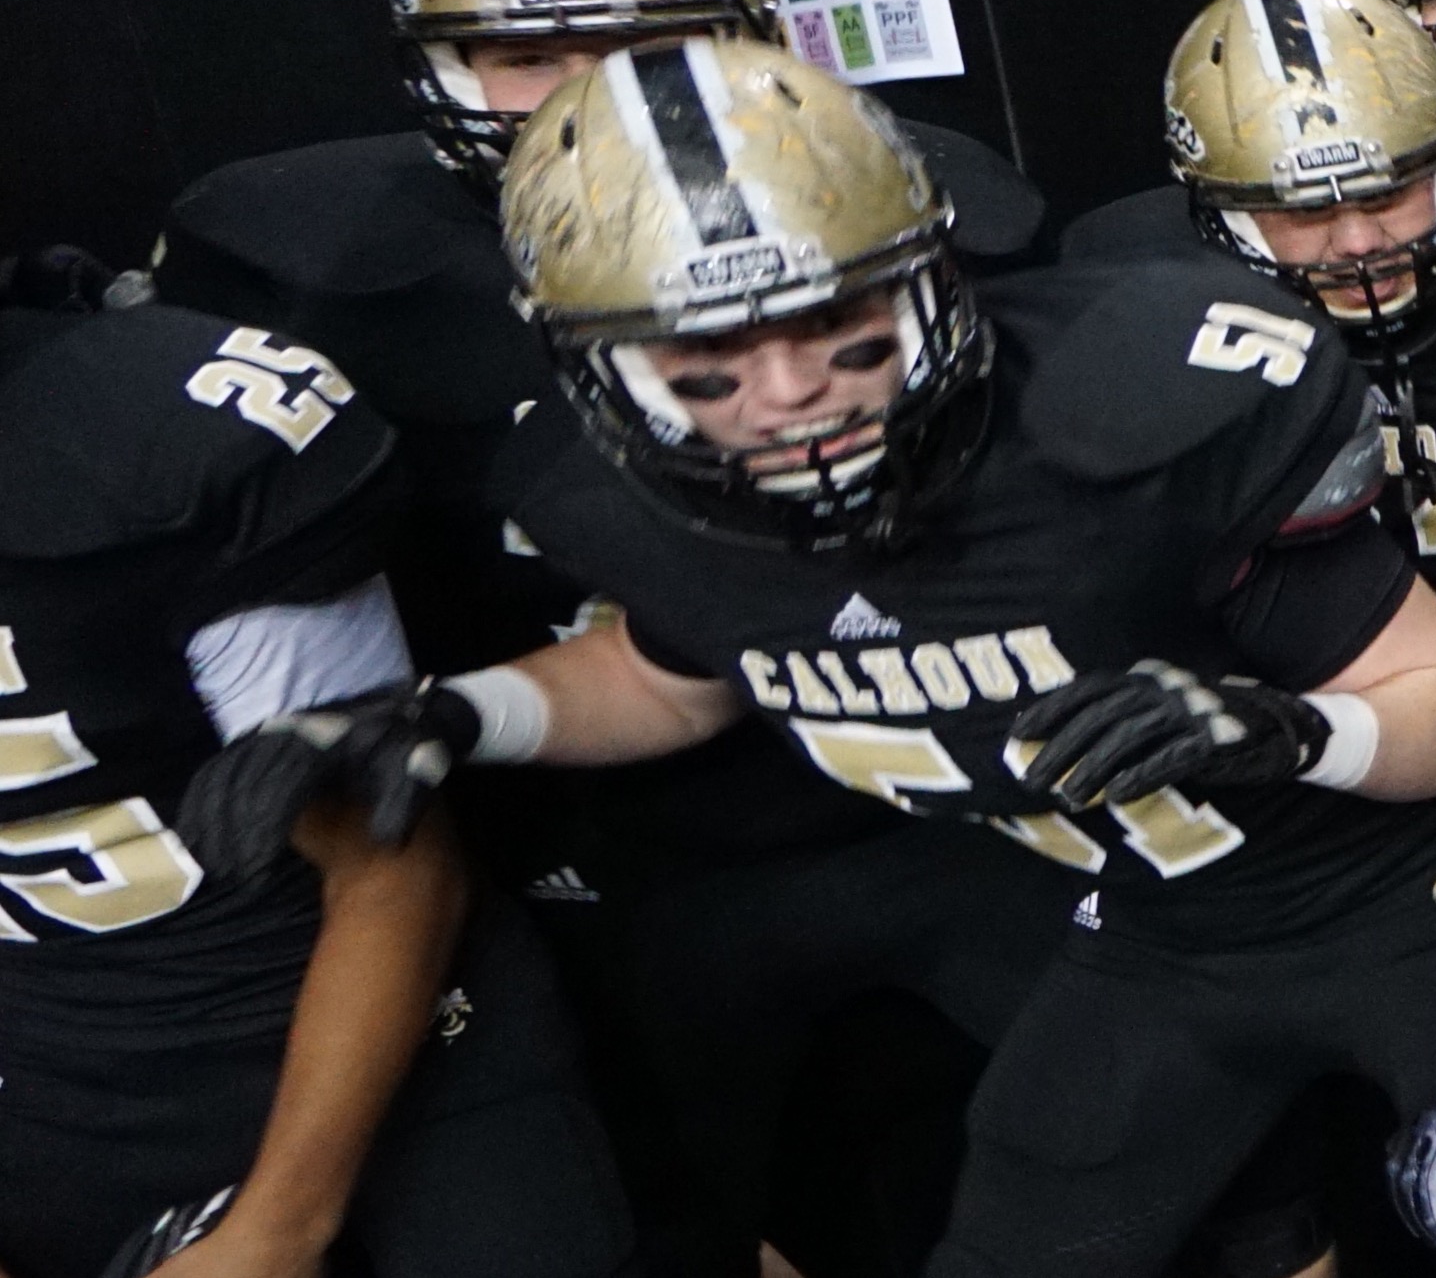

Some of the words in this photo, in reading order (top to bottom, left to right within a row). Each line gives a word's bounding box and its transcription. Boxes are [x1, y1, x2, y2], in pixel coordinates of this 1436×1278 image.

[842, 19, 861, 33] AA
[1299, 141, 1360, 171] SWARM
[1187, 302, 1316, 388] 51
[185, 327, 356, 455] 25
[740, 625, 1077, 716] CALHOUN
